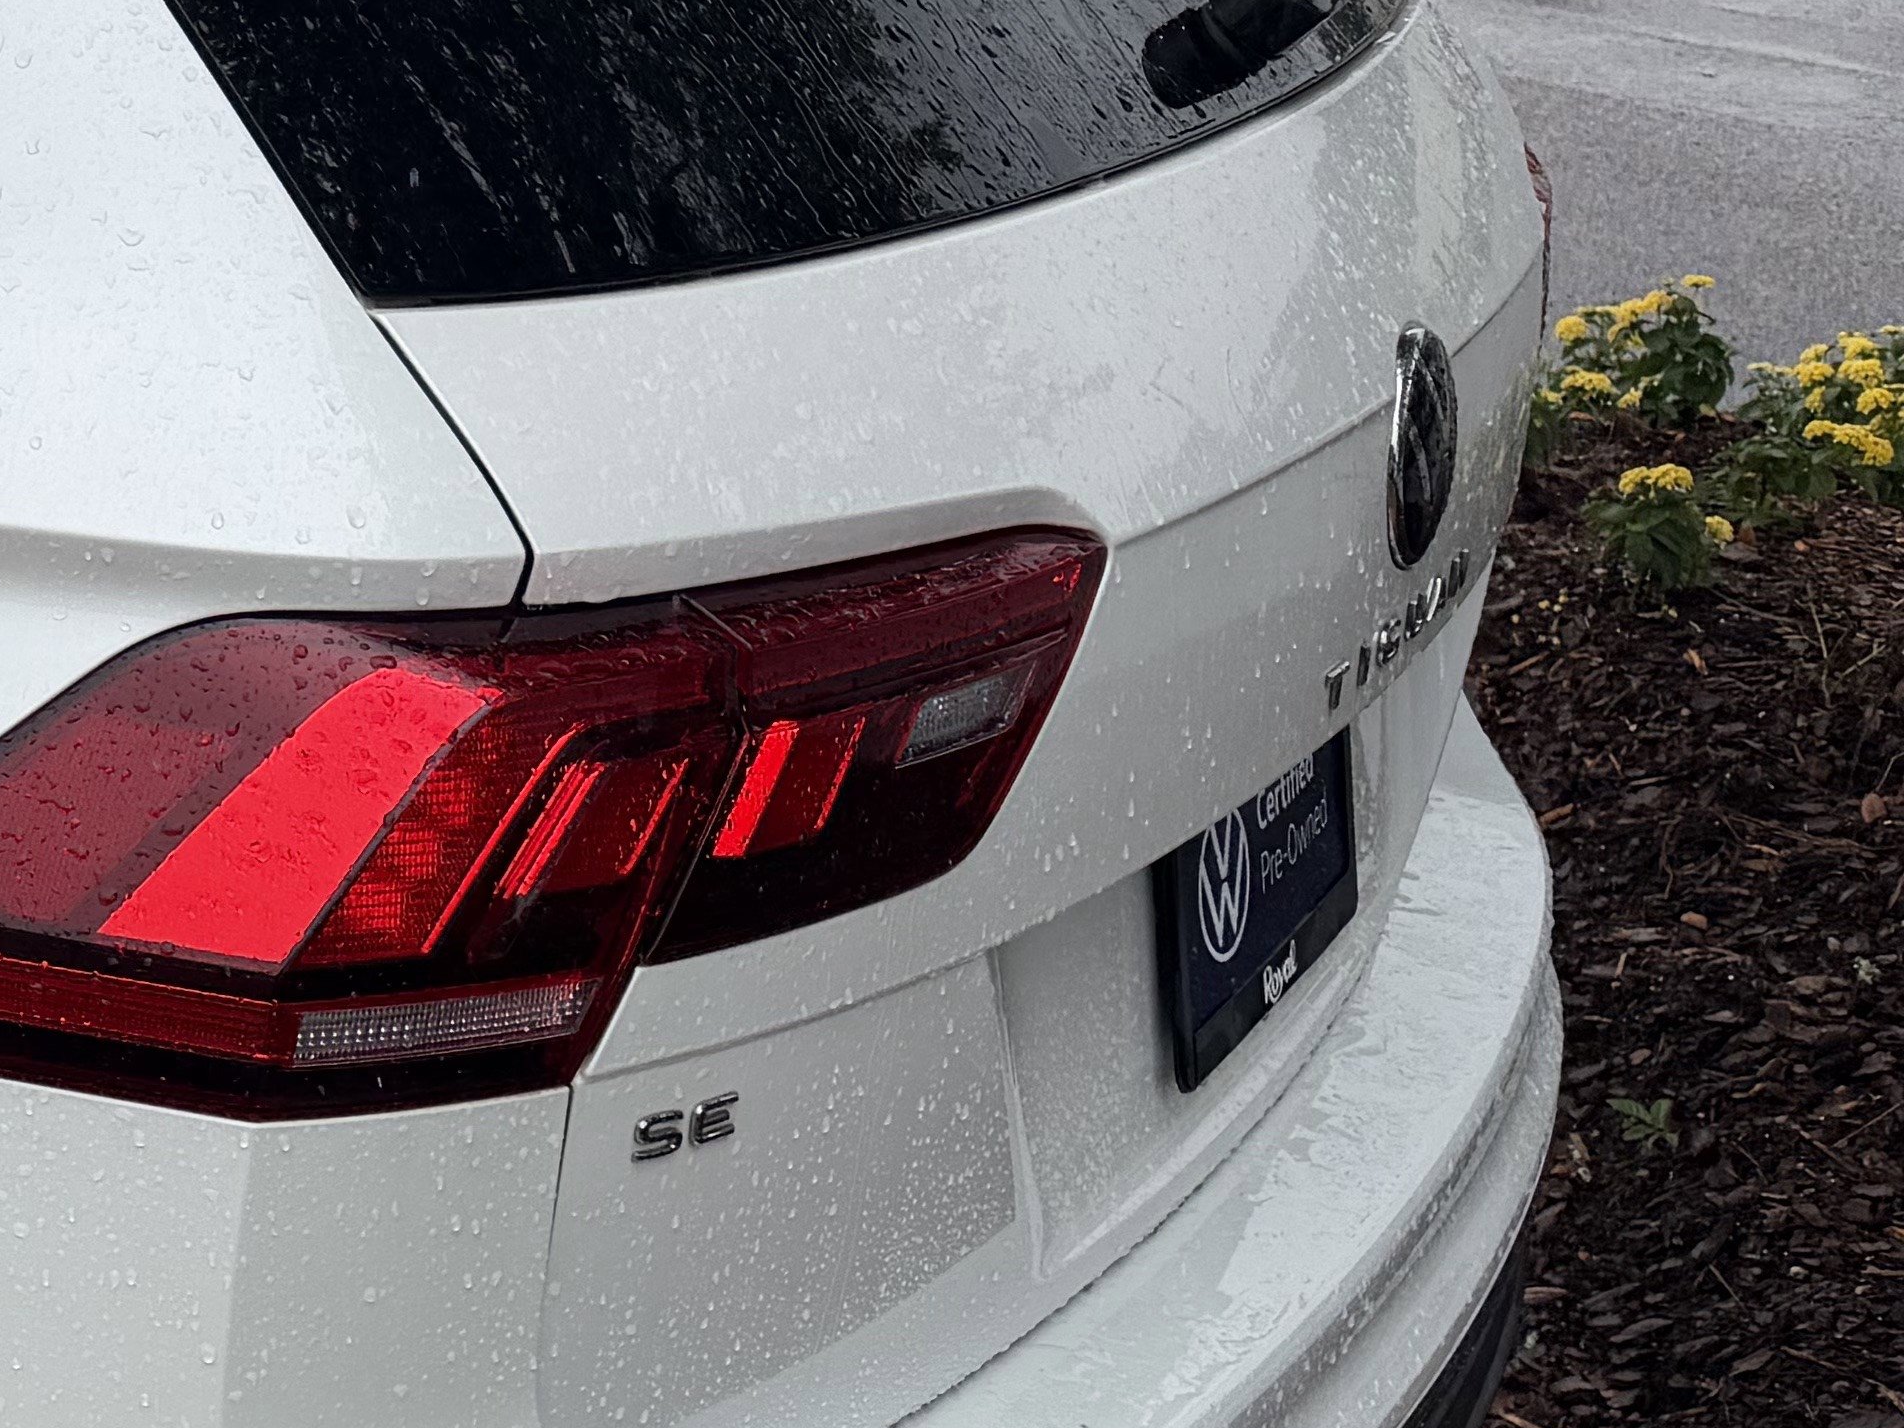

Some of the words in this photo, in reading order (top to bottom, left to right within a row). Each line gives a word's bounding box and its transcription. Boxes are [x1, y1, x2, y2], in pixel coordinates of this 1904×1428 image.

[1261, 784, 1328, 895] Pre-Owned
[1263, 939, 1298, 1004] Royal
[631, 1090, 740, 1163] SE
